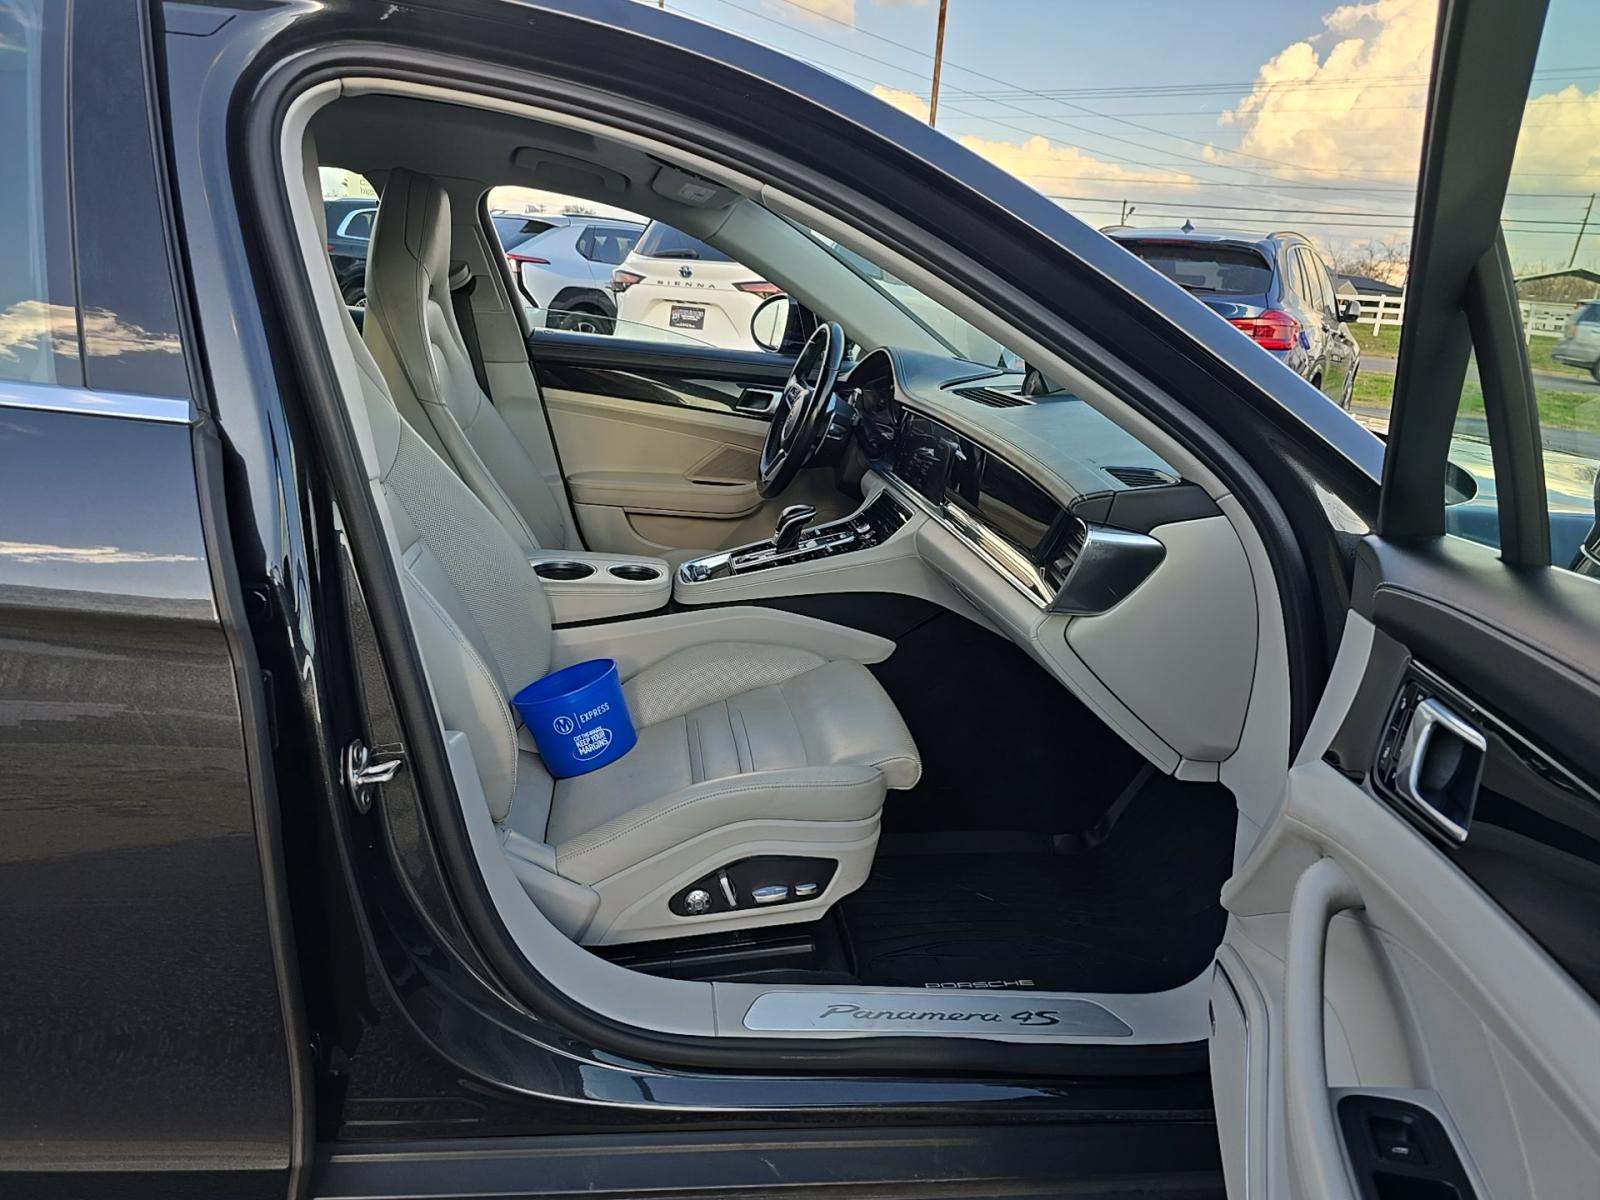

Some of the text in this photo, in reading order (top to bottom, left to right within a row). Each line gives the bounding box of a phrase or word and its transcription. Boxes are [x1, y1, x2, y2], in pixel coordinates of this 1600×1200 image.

[657, 280, 715, 288] SIENNA
[580, 702, 610, 724] EXPRESS
[575, 731, 606, 748] KEEP YOUR
[578, 739, 608, 755] MARGINS
[925, 979, 1035, 989] PORSCHE
[820, 1004, 1060, 1026] Panamera 4S
